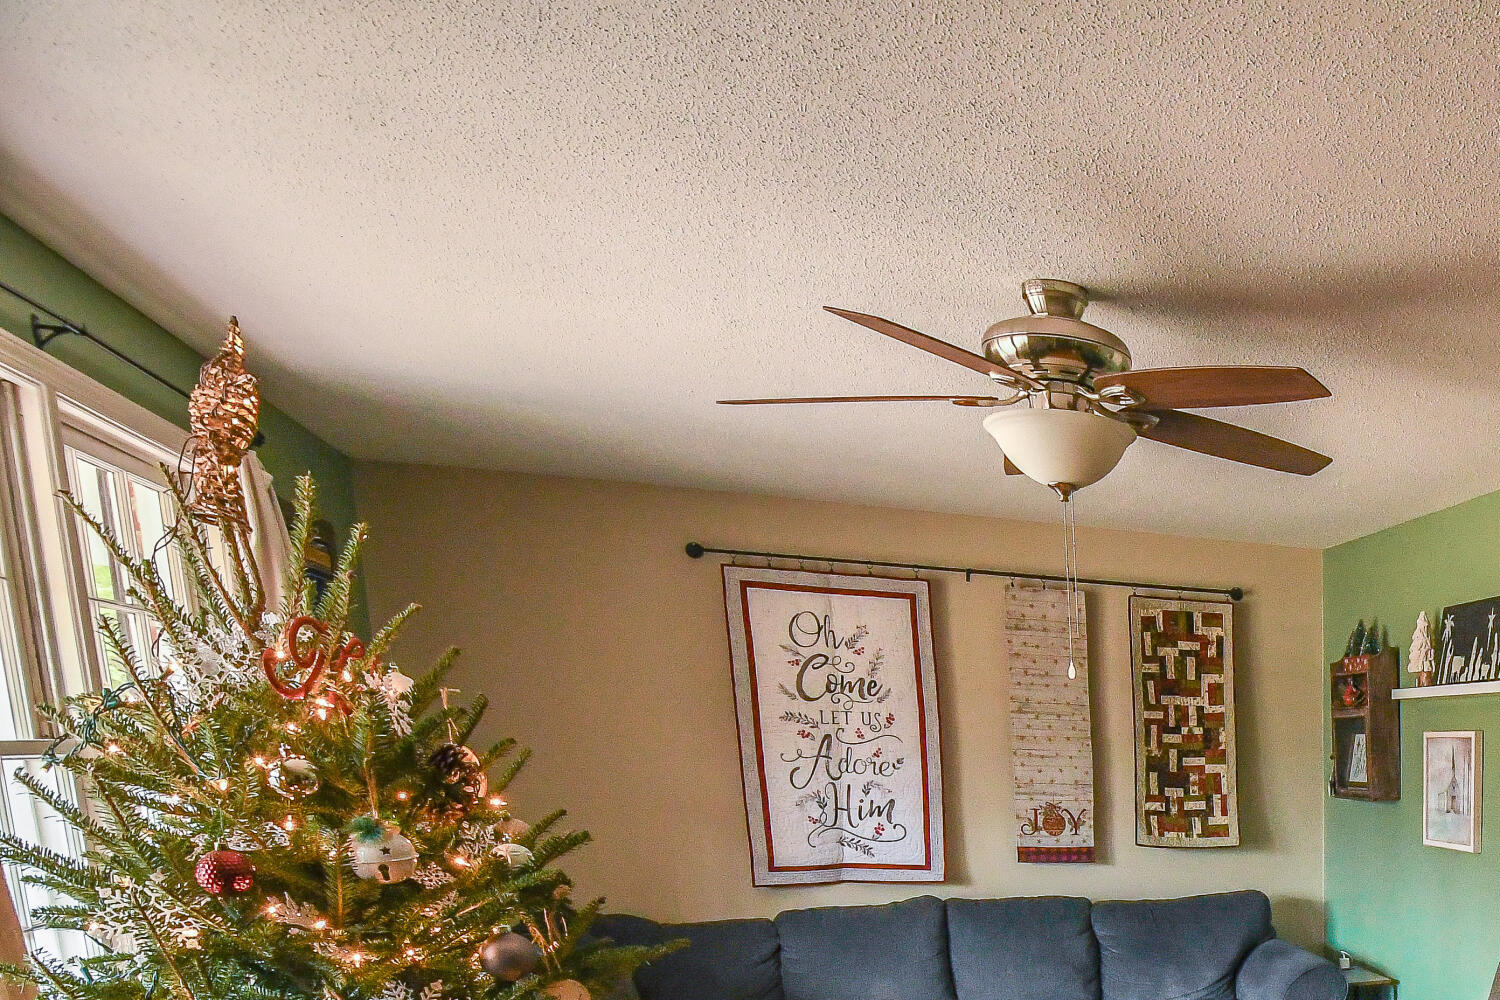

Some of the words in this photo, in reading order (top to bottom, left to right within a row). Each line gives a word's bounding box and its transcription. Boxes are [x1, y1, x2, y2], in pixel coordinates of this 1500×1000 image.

[788, 611, 845, 649] Oh
[796, 653, 884, 702] Come
[819, 710, 852, 725] LET
[861, 711, 882, 732] US
[780, 733, 896, 789] Adore
[821, 782, 896, 828] Him
